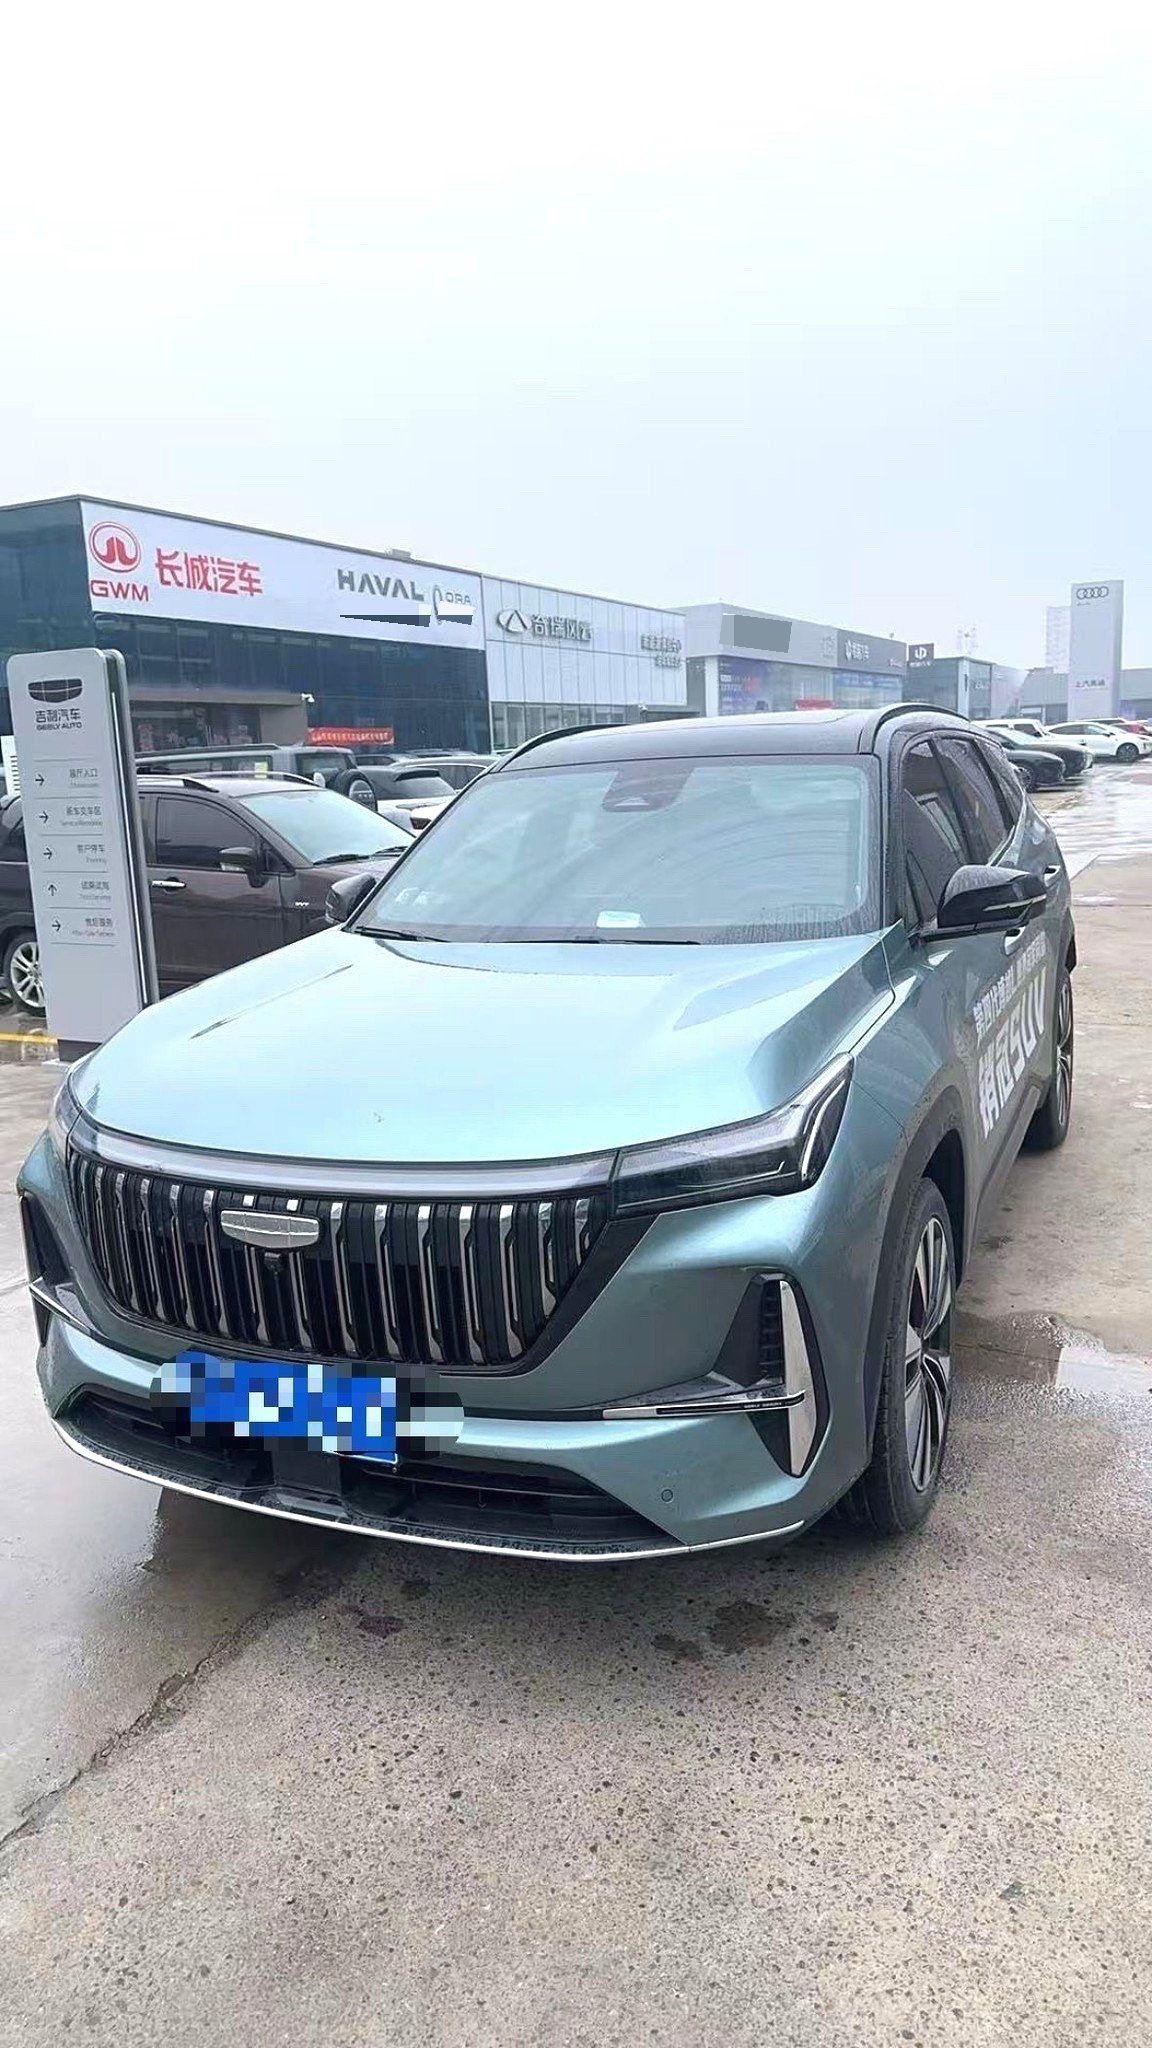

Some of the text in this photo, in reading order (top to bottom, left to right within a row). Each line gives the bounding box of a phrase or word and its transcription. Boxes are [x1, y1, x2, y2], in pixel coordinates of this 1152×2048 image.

[154, 548, 263, 597] 长城汽车
[90, 579, 149, 602] GWM
[337, 568, 425, 602] HAVAL
[35, 708, 81, 723] 吉利汽车
[61, 721, 83, 730] AUTO
